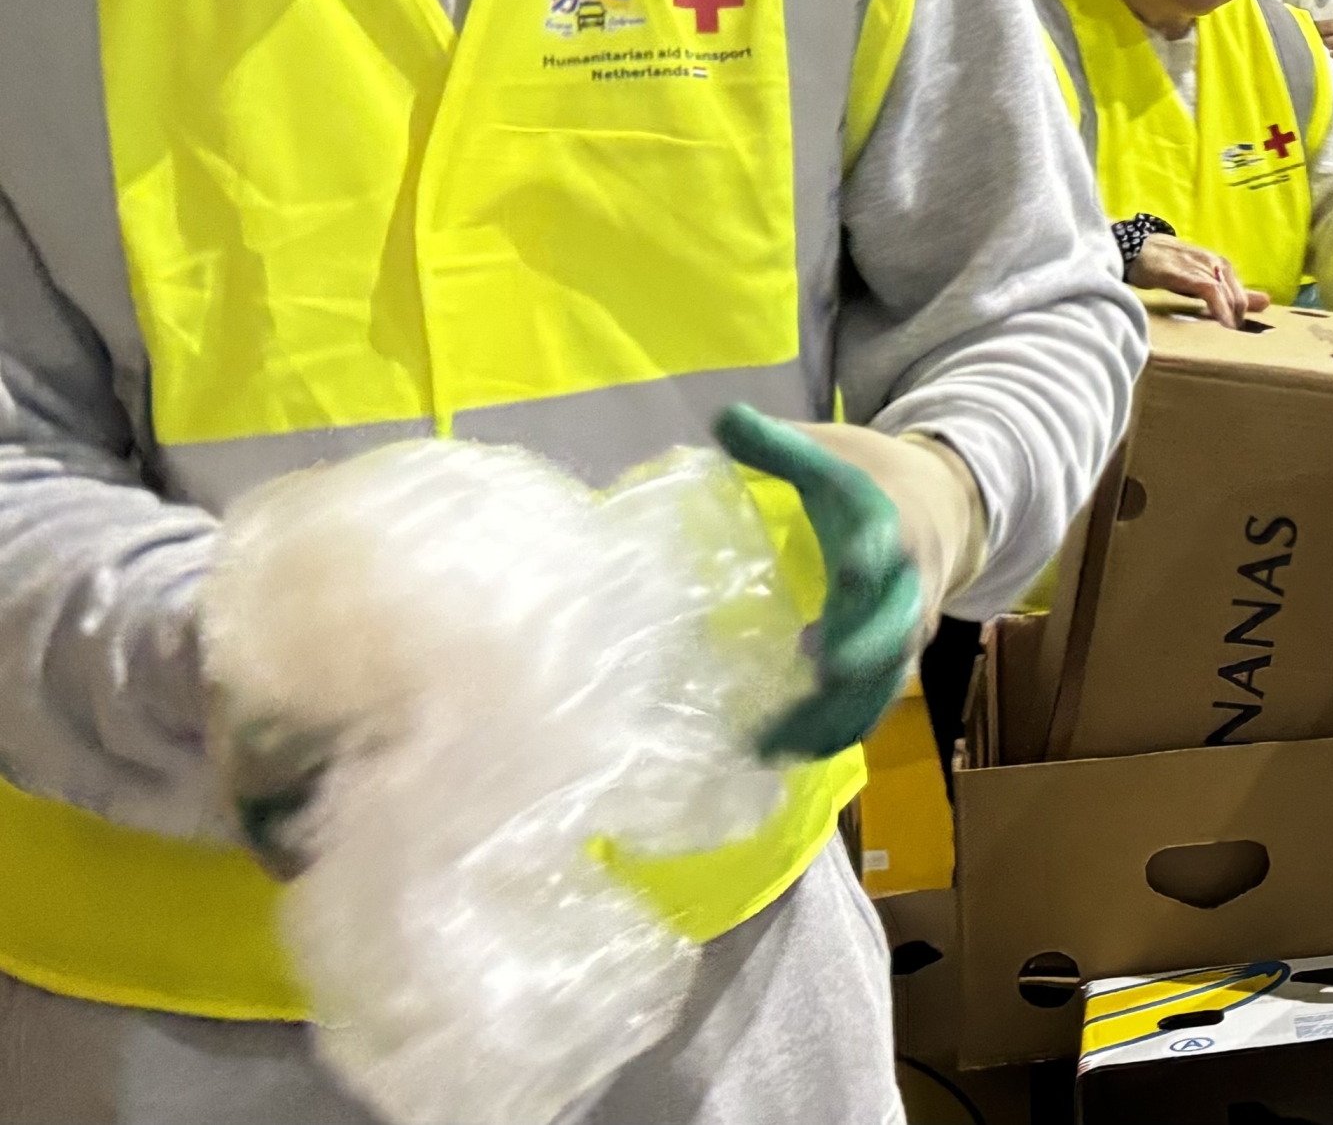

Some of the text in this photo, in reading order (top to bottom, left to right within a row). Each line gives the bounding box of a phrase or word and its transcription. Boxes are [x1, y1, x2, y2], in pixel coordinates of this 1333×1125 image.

[543, 48, 655, 68] Humanitarian
[657, 47, 682, 60] aid
[591, 64, 691, 81] Netherlands
